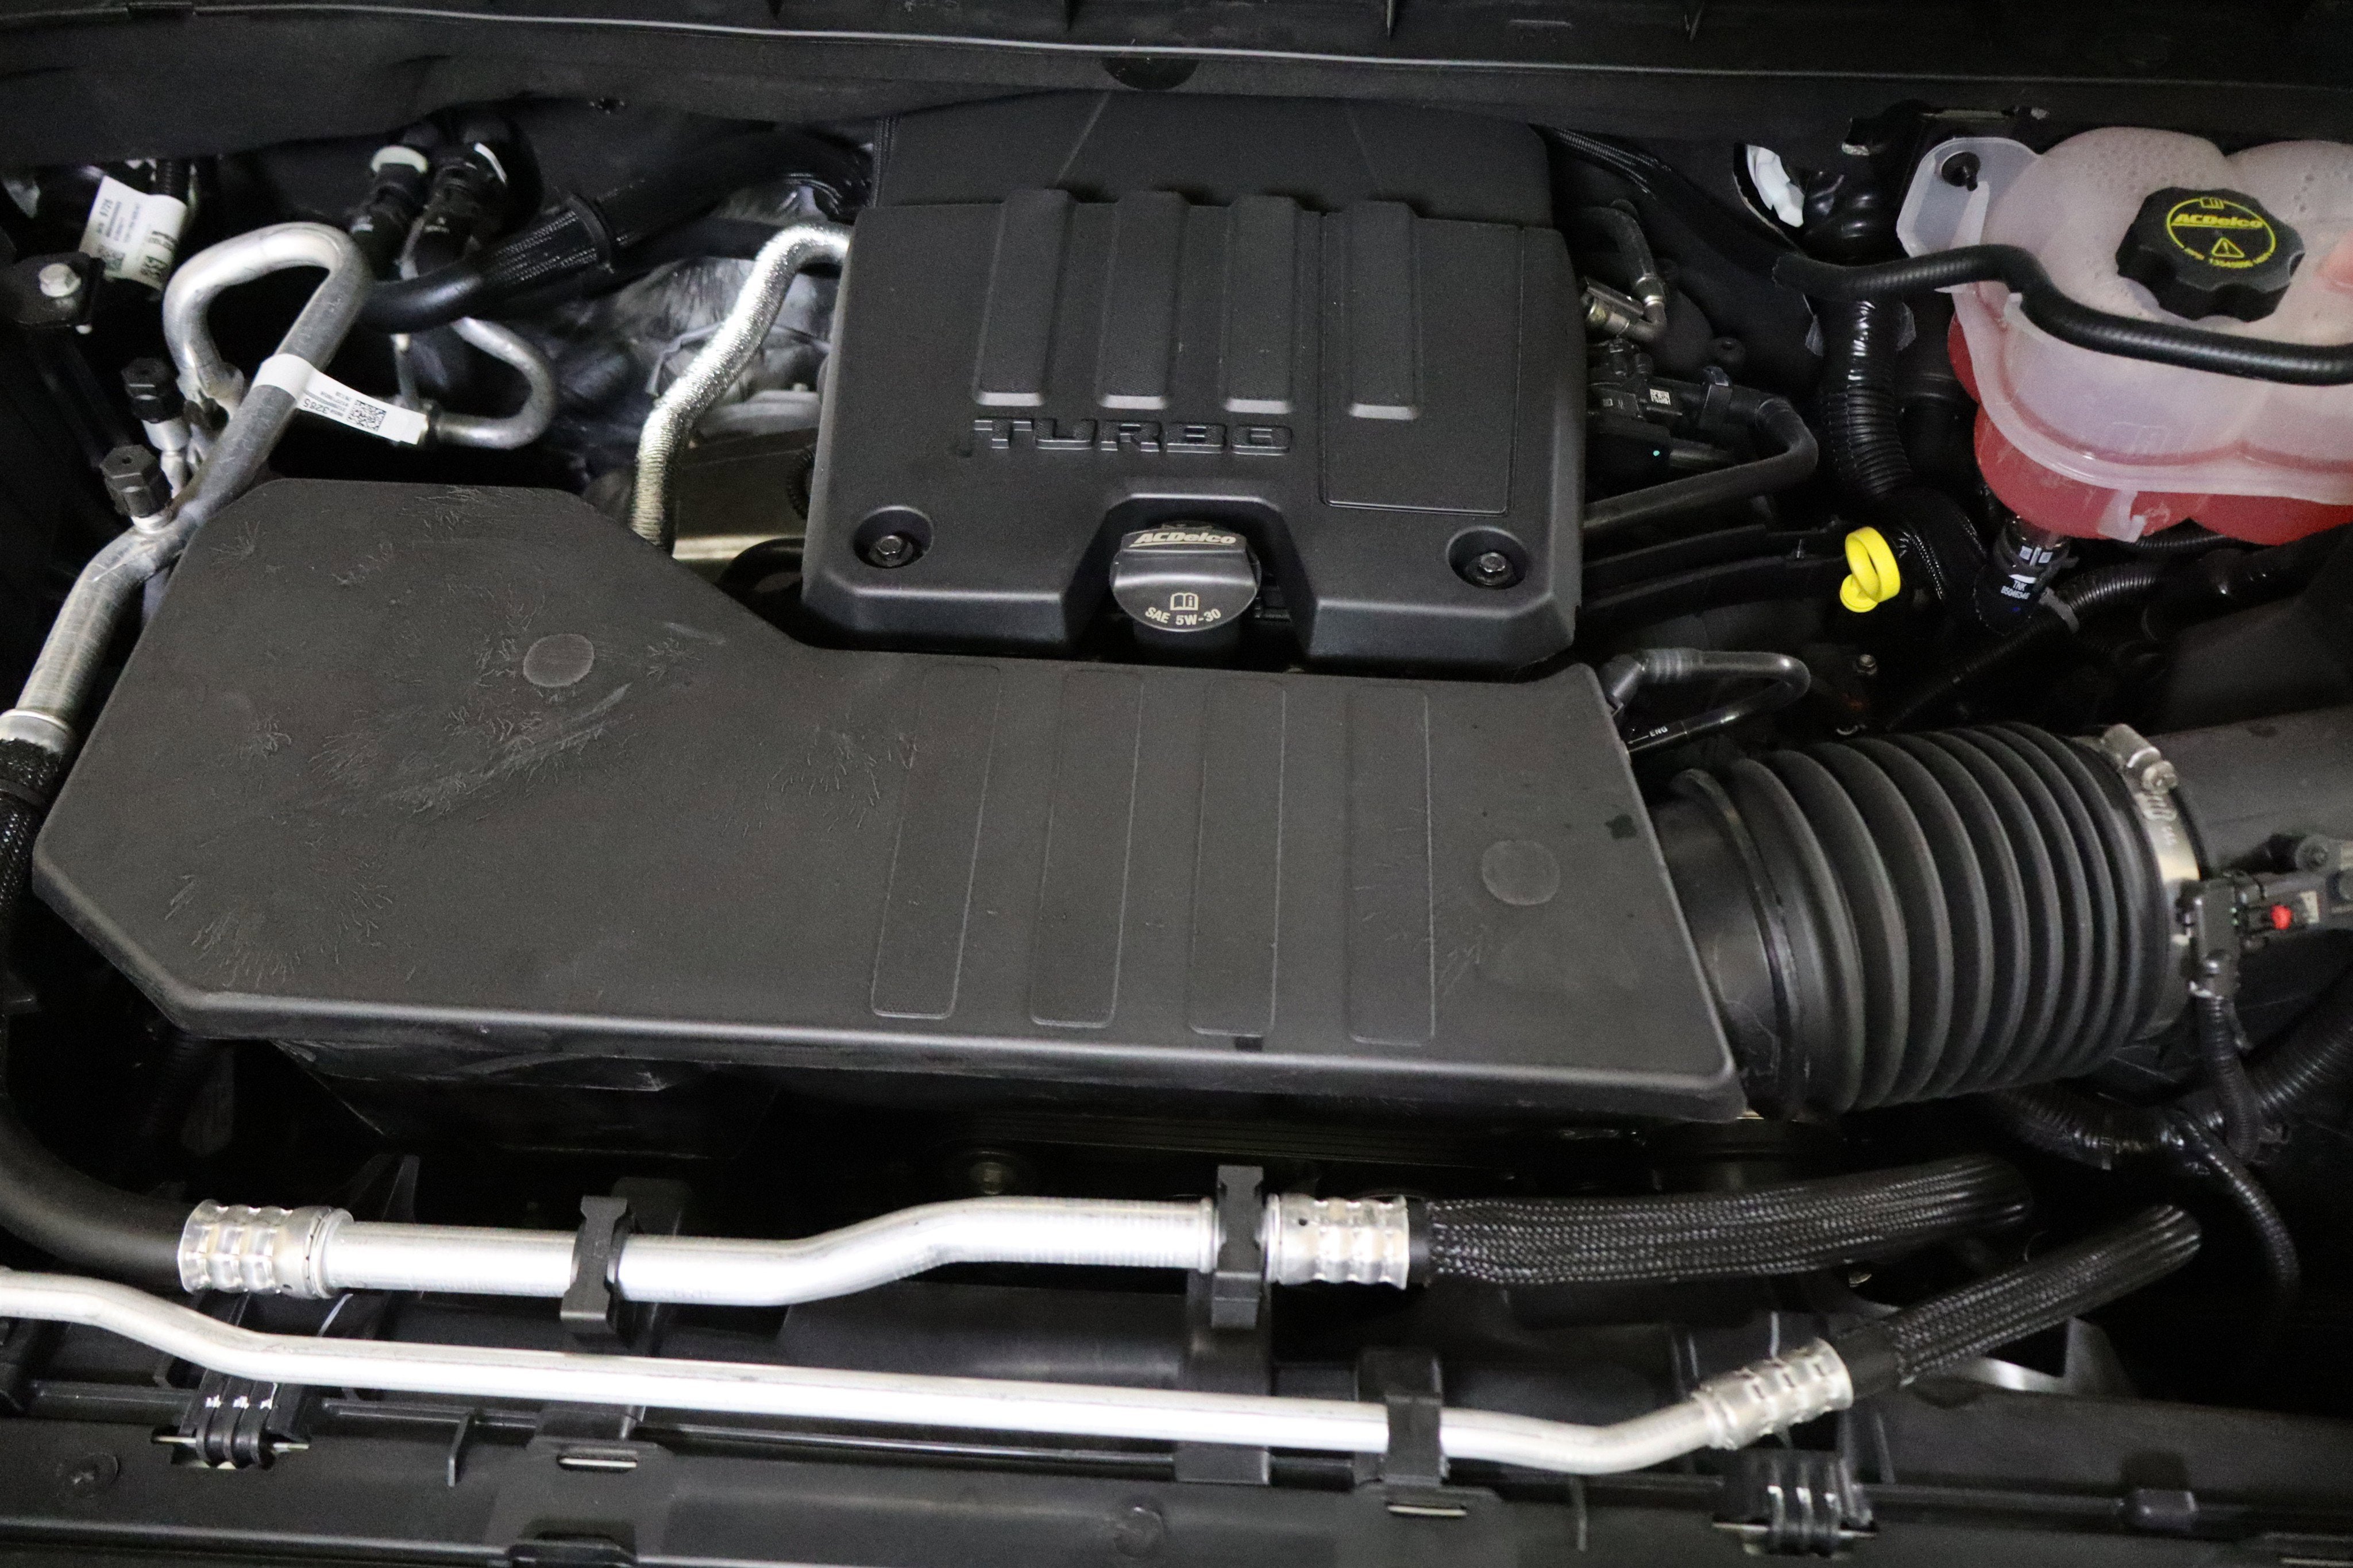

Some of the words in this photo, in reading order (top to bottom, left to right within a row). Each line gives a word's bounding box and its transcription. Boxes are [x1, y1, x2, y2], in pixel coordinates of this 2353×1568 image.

[2171, 213, 2263, 228] ACDelco
[303, 399, 329, 414] 3285
[974, 418, 1291, 455] TURBO
[1132, 532, 1236, 546] ACDelco
[2013, 580, 2027, 591] TNK
[1145, 607, 1171, 624] SAE
[1175, 609, 1221, 625] 5W-30
[1649, 726, 1668, 737] ENG
